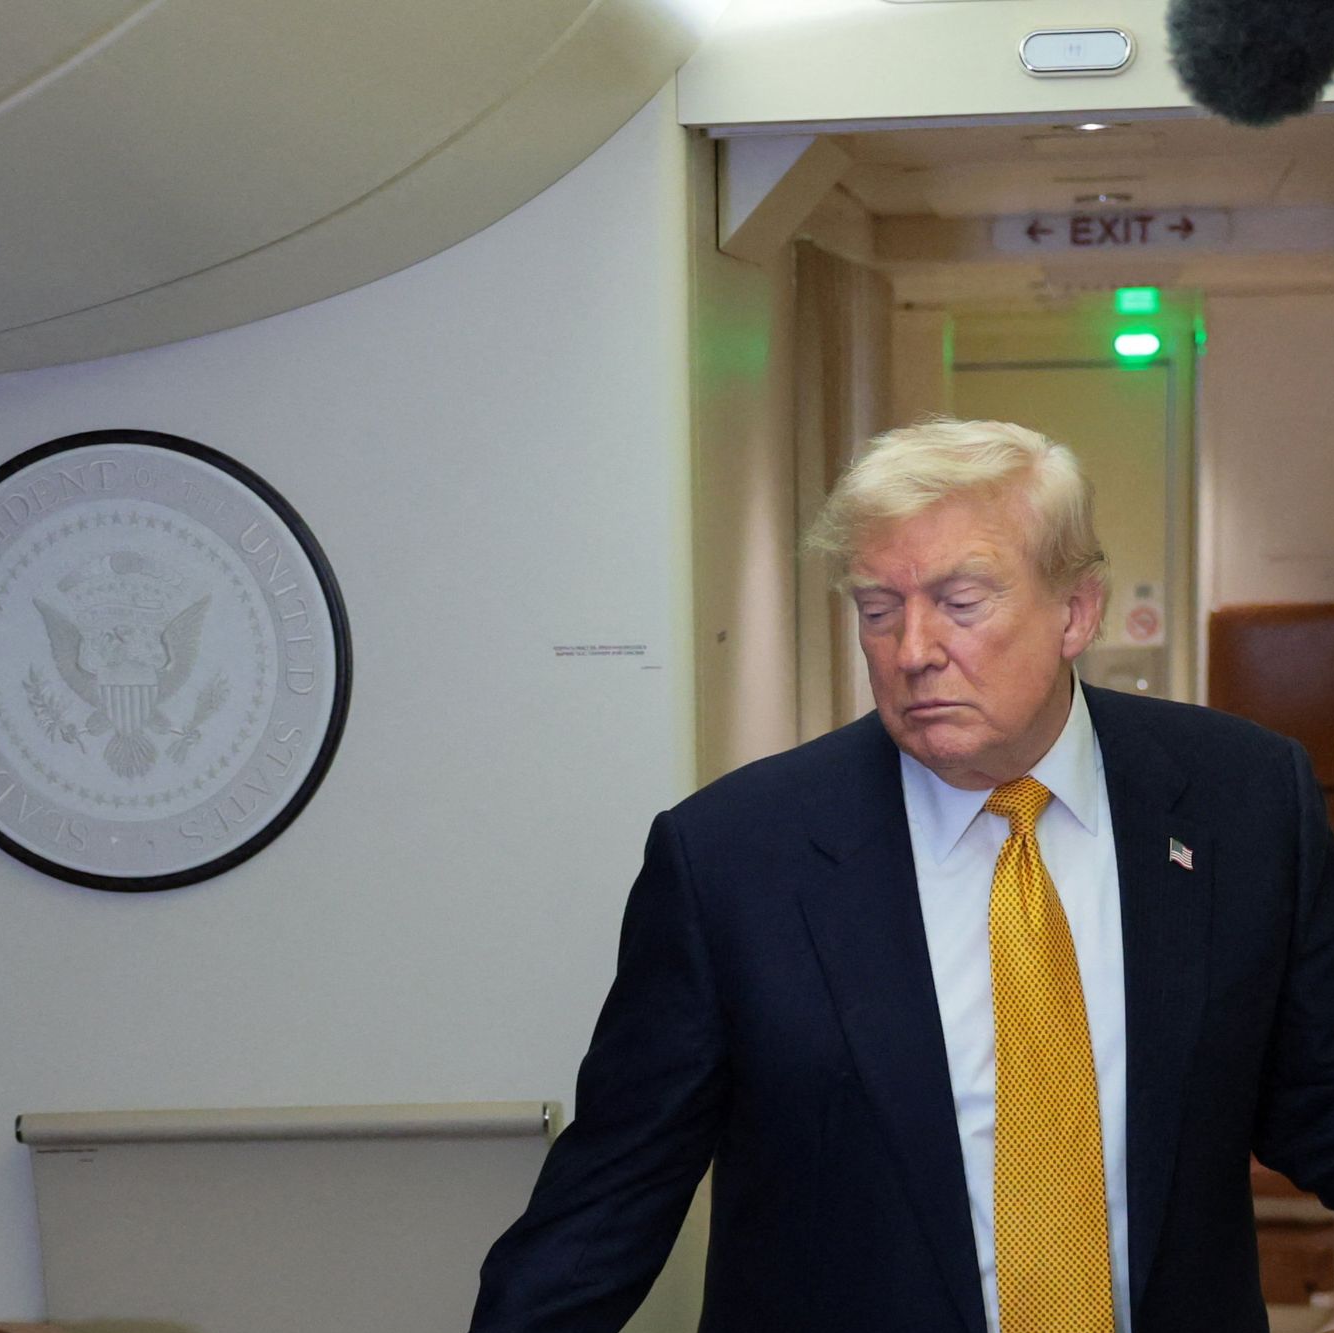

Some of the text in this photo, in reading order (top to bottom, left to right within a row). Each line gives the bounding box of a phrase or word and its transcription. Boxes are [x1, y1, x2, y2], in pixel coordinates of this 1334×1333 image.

[1070, 216, 1154, 246] EXIT
[240, 521, 315, 695] UNITED
[179, 720, 303, 849] STATES
